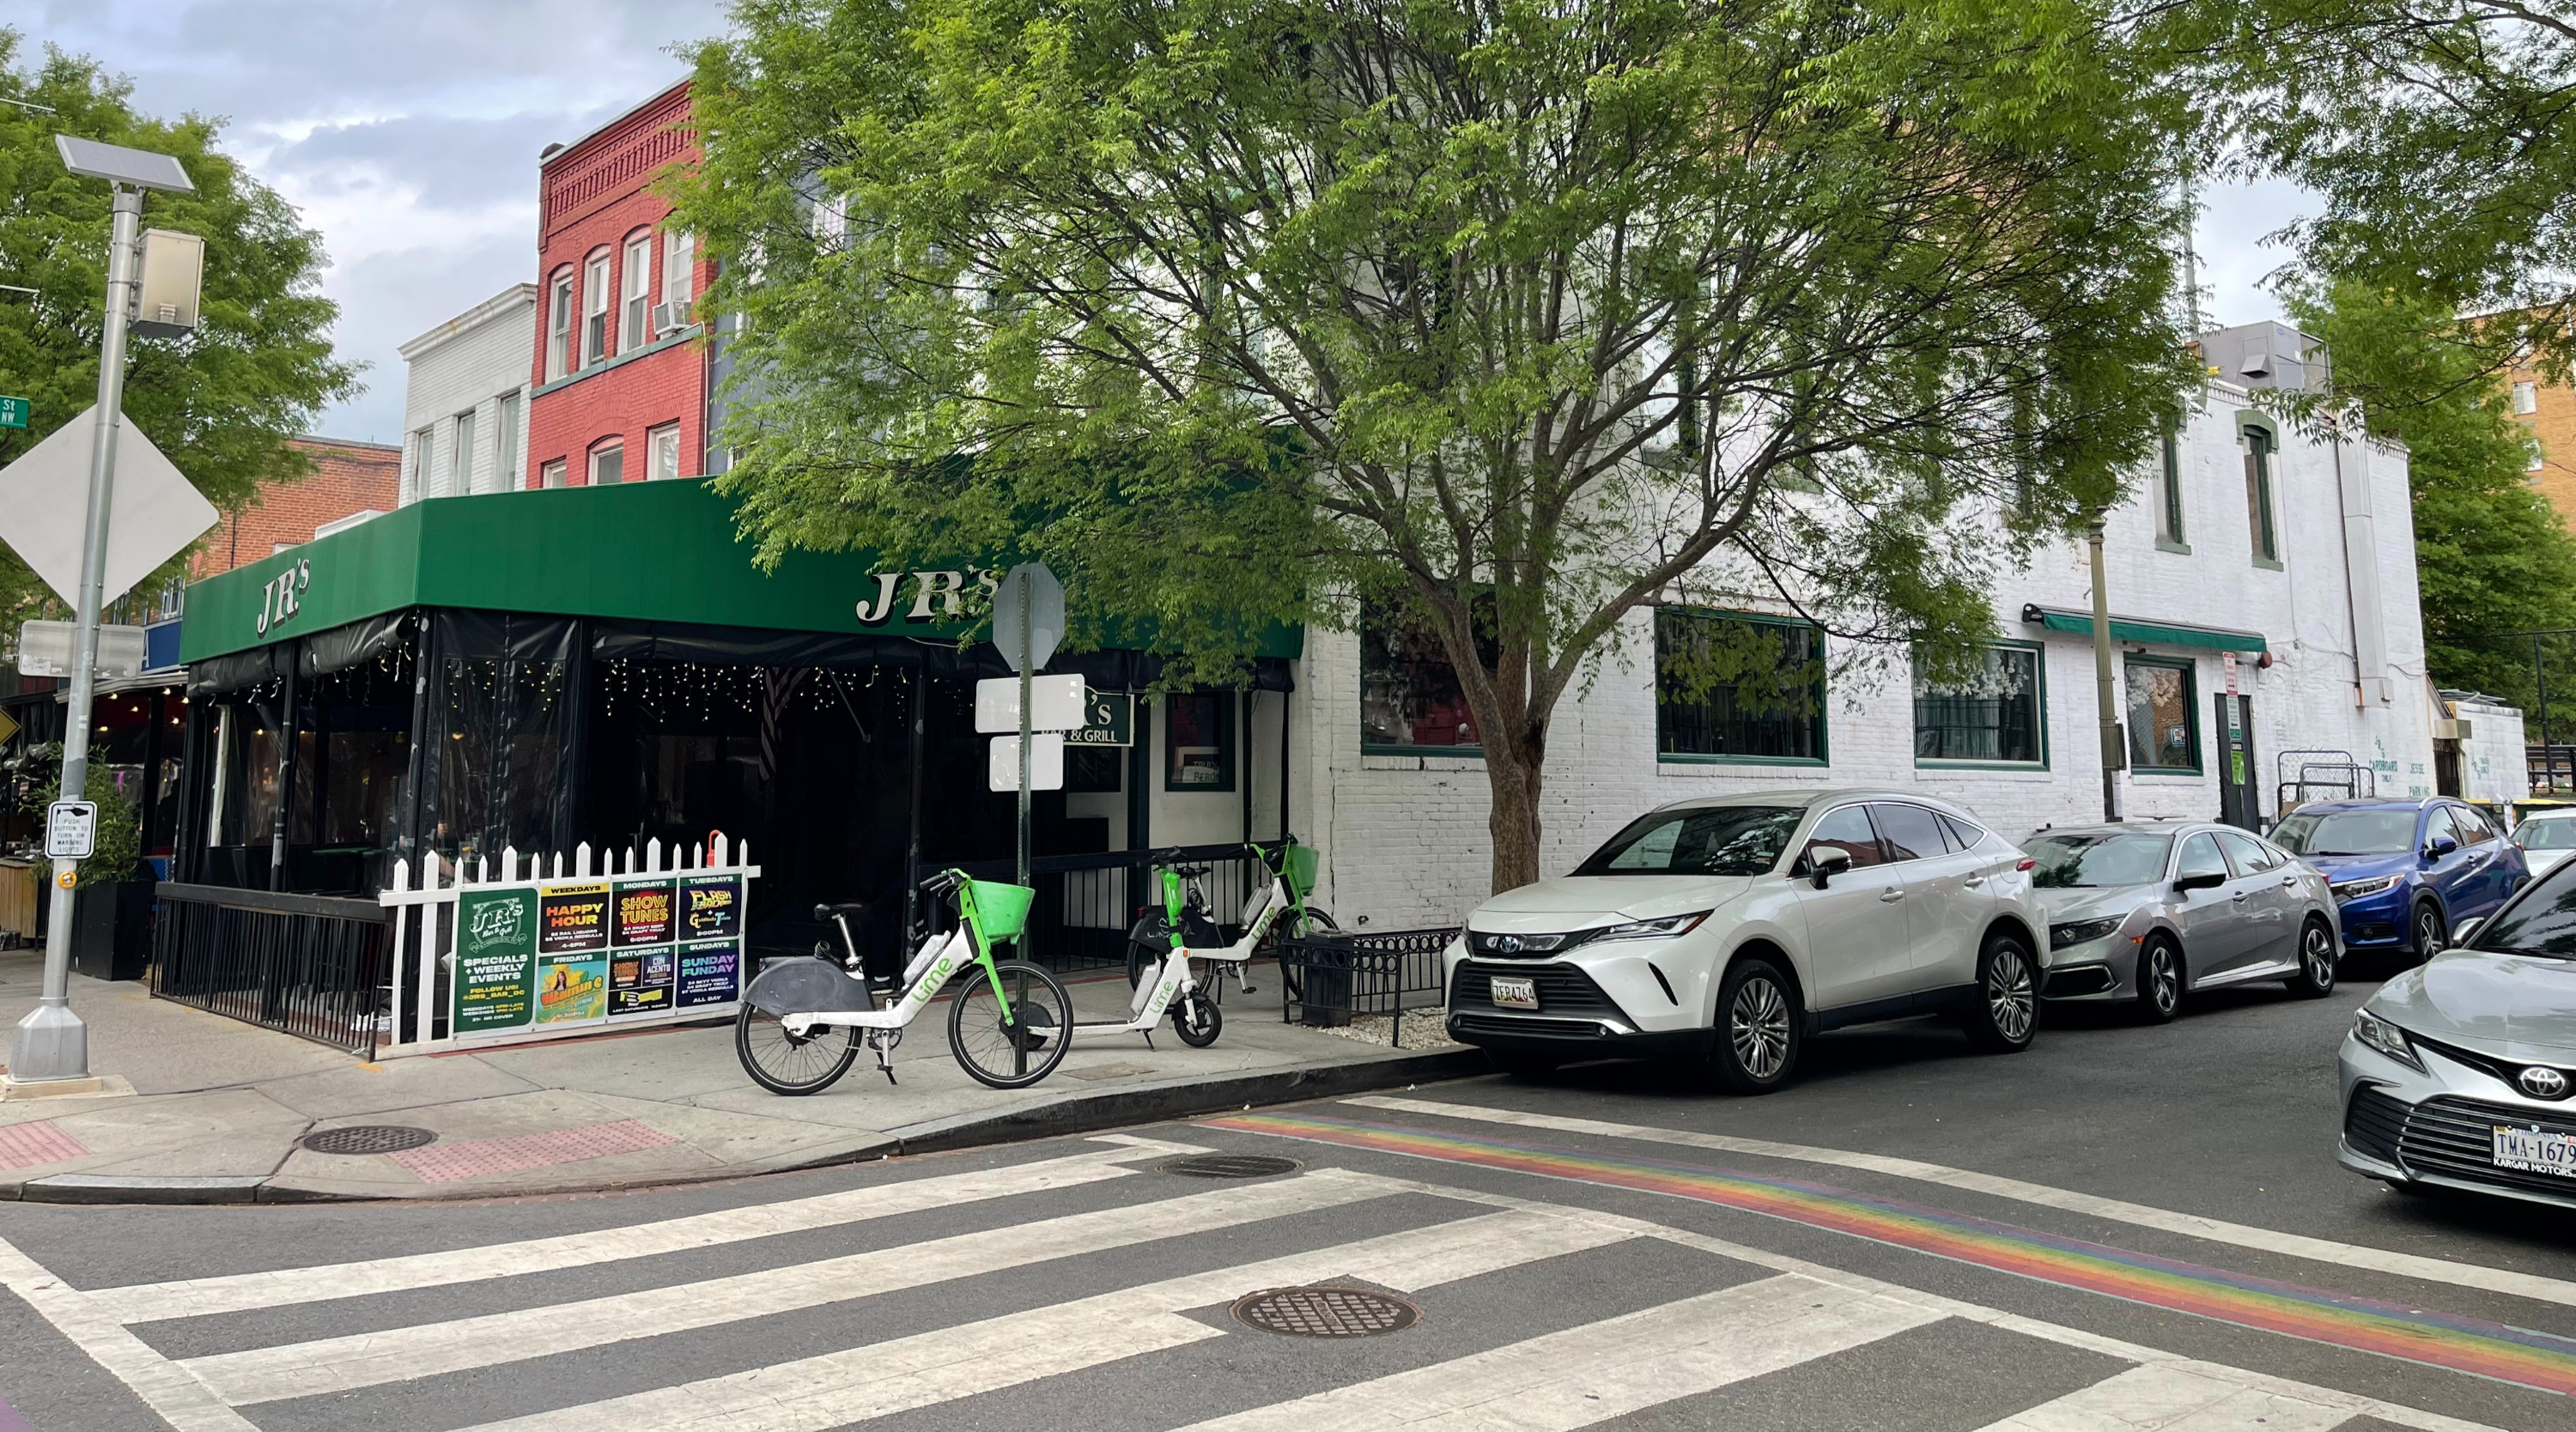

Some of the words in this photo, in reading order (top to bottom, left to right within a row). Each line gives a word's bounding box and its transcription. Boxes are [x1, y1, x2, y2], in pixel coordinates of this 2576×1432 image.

[3, 399, 15, 411] St
[2, 411, 15, 423] NW
[1070, 730, 1082, 742] &
[1084, 729, 1118, 743] GRILL
[2409, 786, 2430, 797] PARKING
[623, 881, 667, 889] MONDAYS
[689, 876, 733, 884] TUESDAYS
[551, 885, 601, 894] WEEKDAYS
[690, 890, 732, 901] FLASH
[621, 895, 669, 911] SHOW
[546, 903, 604, 917] HAPPY
[620, 907, 669, 925] TUNES
[551, 914, 598, 927] HOUR
[1251, 906, 1276, 941] Lime
[690, 941, 730, 950] SUNDAYS
[553, 954, 593, 963] FRIDAYS
[616, 947, 669, 958] SATURDAYS
[464, 954, 528, 967] SPECIALS
[681, 955, 736, 968] SUNDAY
[474, 963, 526, 974] WEEKLY
[647, 963, 671, 974] ACENTO
[682, 963, 735, 977] FUNDAY
[469, 972, 521, 984] EVENTS
[593, 975, 604, 989] C
[911, 958, 953, 1003] Lime
[1149, 981, 1174, 1014] Lime
[2497, 1133, 2576, 1165] TMA-1679
[2493, 1156, 2530, 1171] KARGAR
[2530, 1162, 2573, 1177] MOTORS
